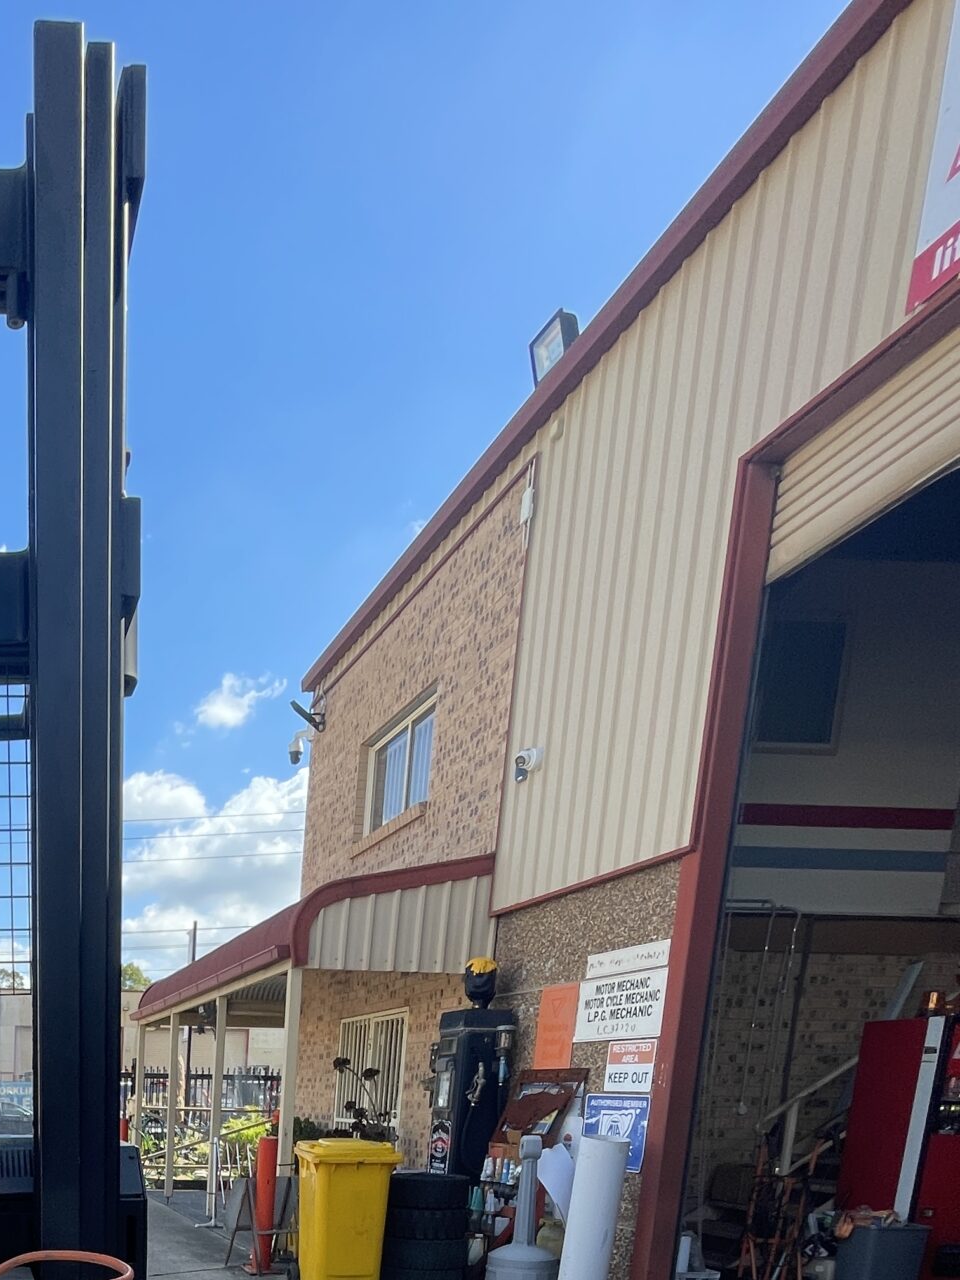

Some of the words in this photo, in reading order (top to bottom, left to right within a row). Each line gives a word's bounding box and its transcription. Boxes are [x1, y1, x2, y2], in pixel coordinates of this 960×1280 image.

[595, 981, 616, 996] MOTOR
[616, 976, 651, 993] MECHANIC
[584, 997, 605, 1011] MOTOR
[605, 994, 623, 1008] CYCLE
[624, 989, 660, 1005] MECHANIC
[609, 1004, 653, 1020] MECHANIC
[612, 1043, 652, 1054] RESTRICTED
[621, 1054, 639, 1063] AREA
[607, 1071, 629, 1084] KEEP
[631, 1071, 649, 1084] OUT
